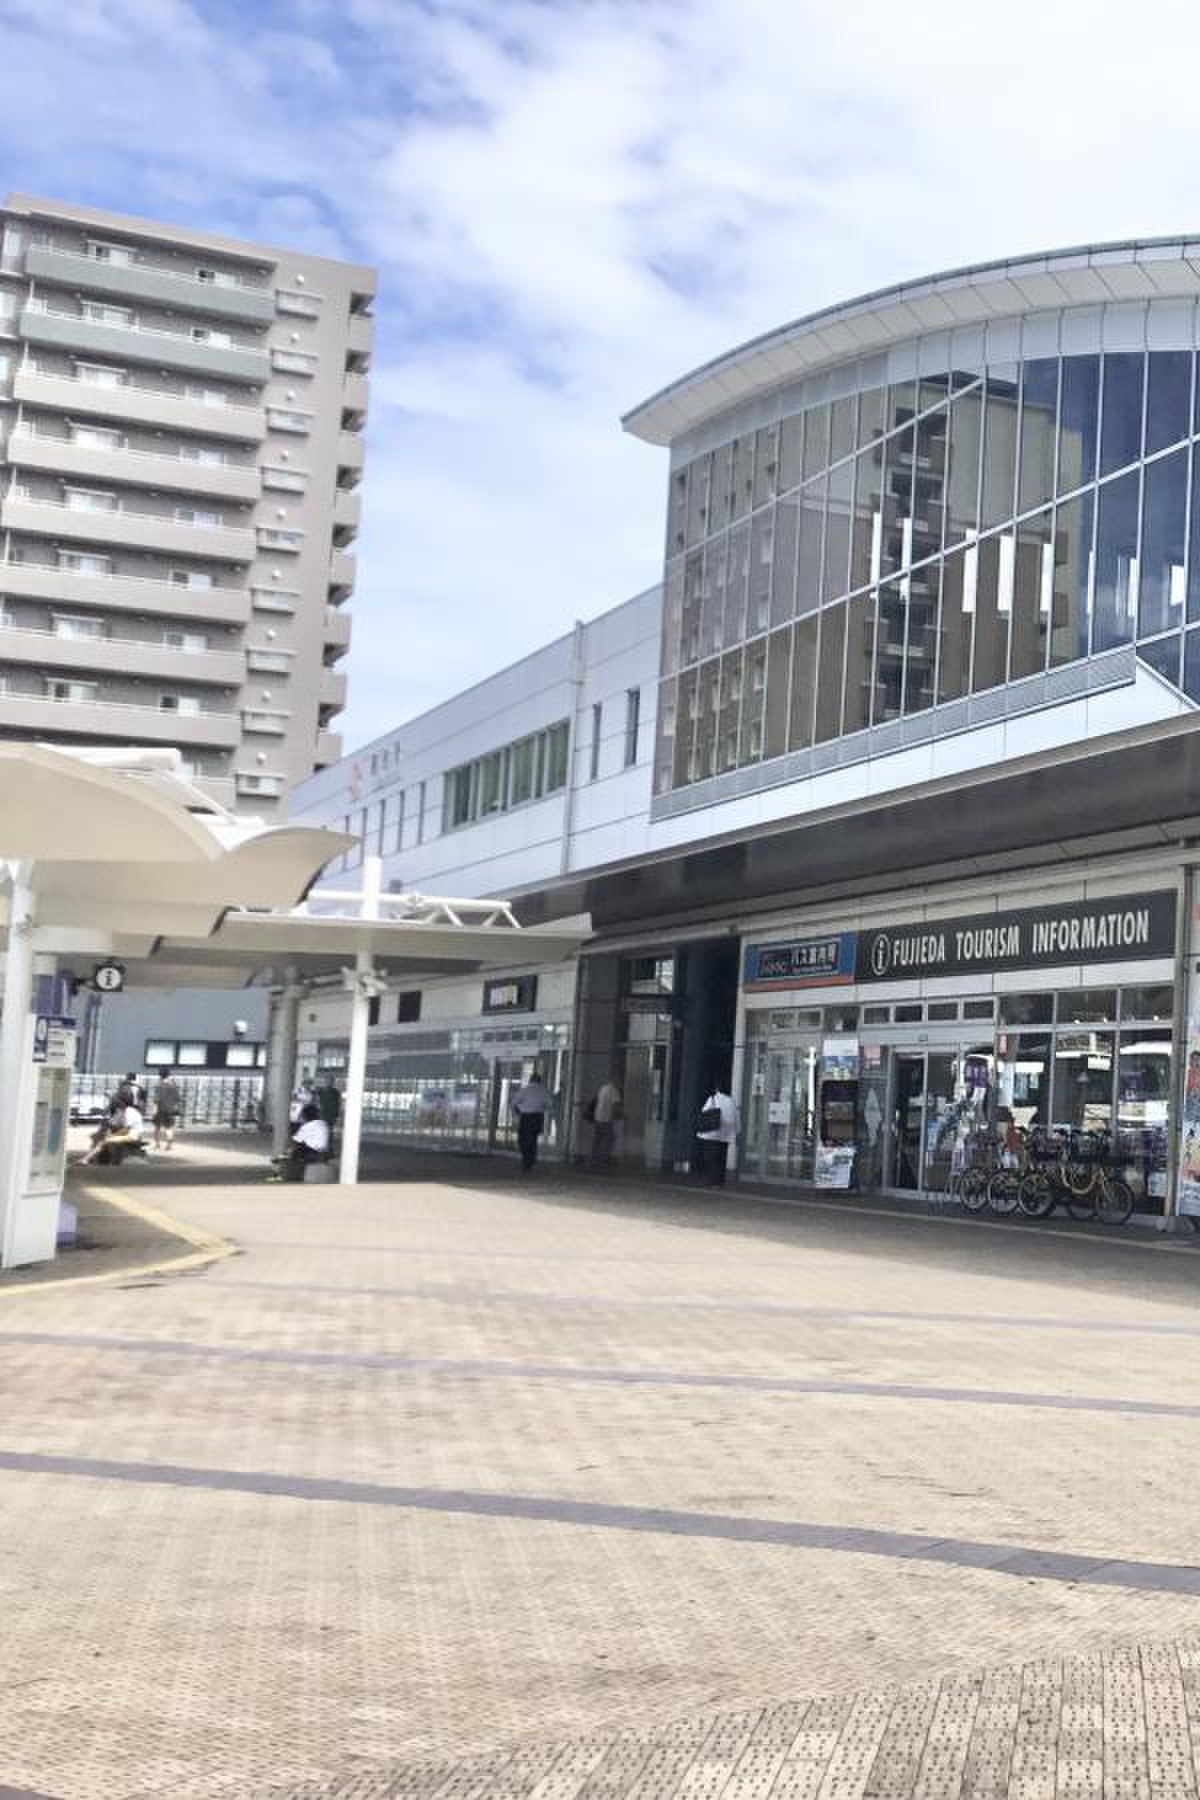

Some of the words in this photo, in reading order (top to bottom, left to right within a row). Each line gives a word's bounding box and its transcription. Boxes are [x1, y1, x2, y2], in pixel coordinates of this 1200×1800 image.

[892, 934, 945, 965] FUJIEDA
[956, 925, 1020, 961] TOURISM
[1032, 908, 1150, 953] INFORMATION
